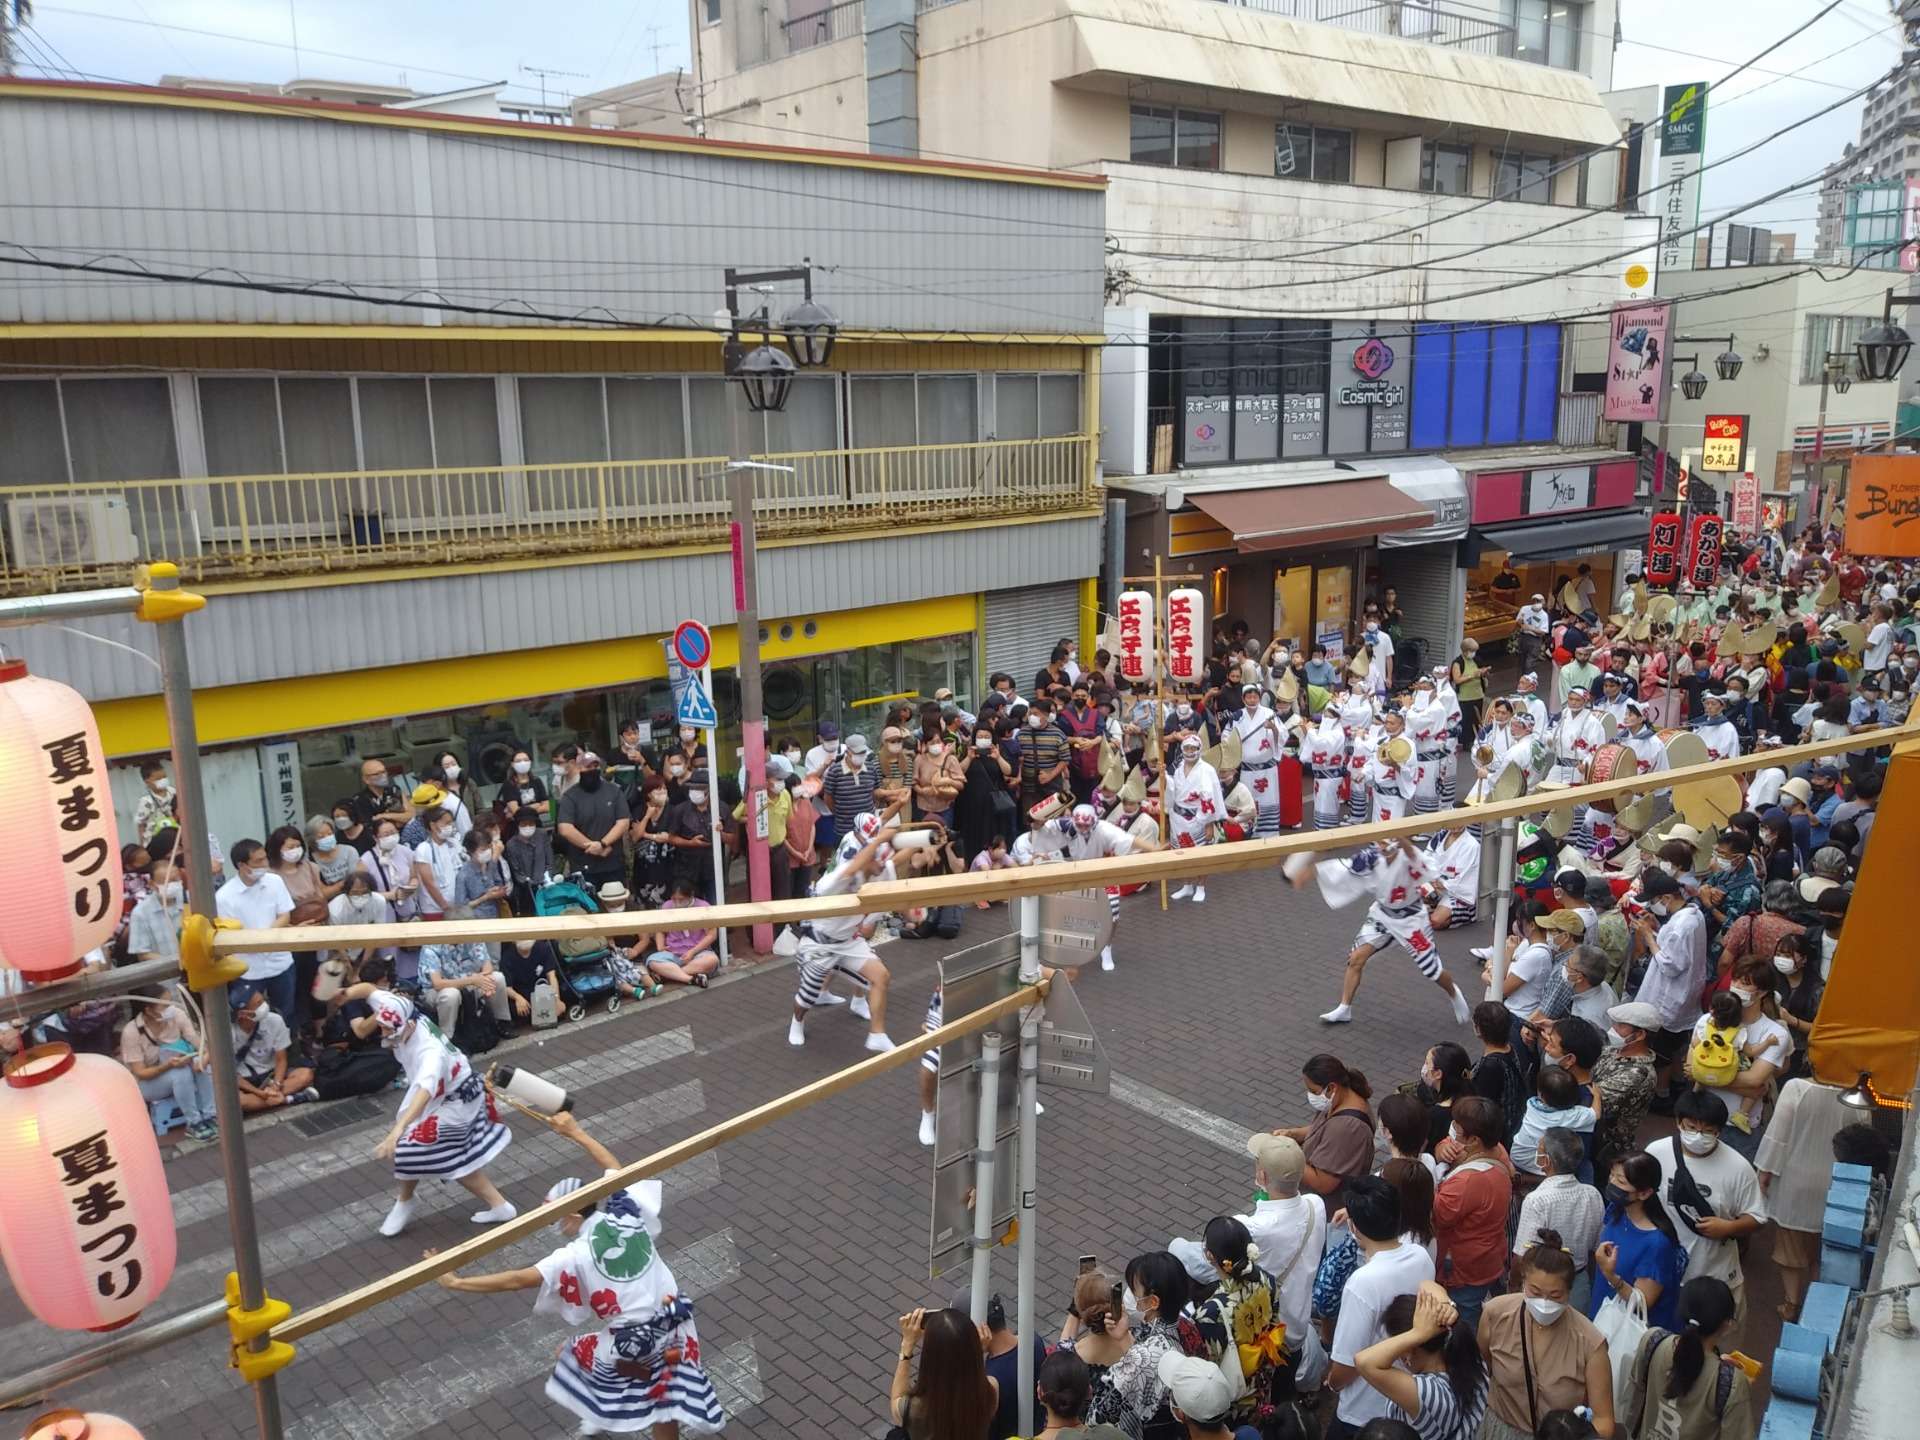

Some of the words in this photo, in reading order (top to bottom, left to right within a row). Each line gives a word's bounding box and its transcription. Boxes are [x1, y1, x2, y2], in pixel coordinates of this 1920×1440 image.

[1667, 123, 1695, 135] SMBC
[1663, 161, 1686, 267] 三井住友銀行
[1616, 313, 1664, 340] Diamond
[1341, 389, 1384, 404] Cosmic
[1385, 387, 1404, 407] girl
[1652, 523, 1678, 574] 灯連
[1694, 520, 1720, 583] あかし連
[42, 731, 112, 924] 夏まつり
[52, 1129, 143, 1301] 夏まつり
